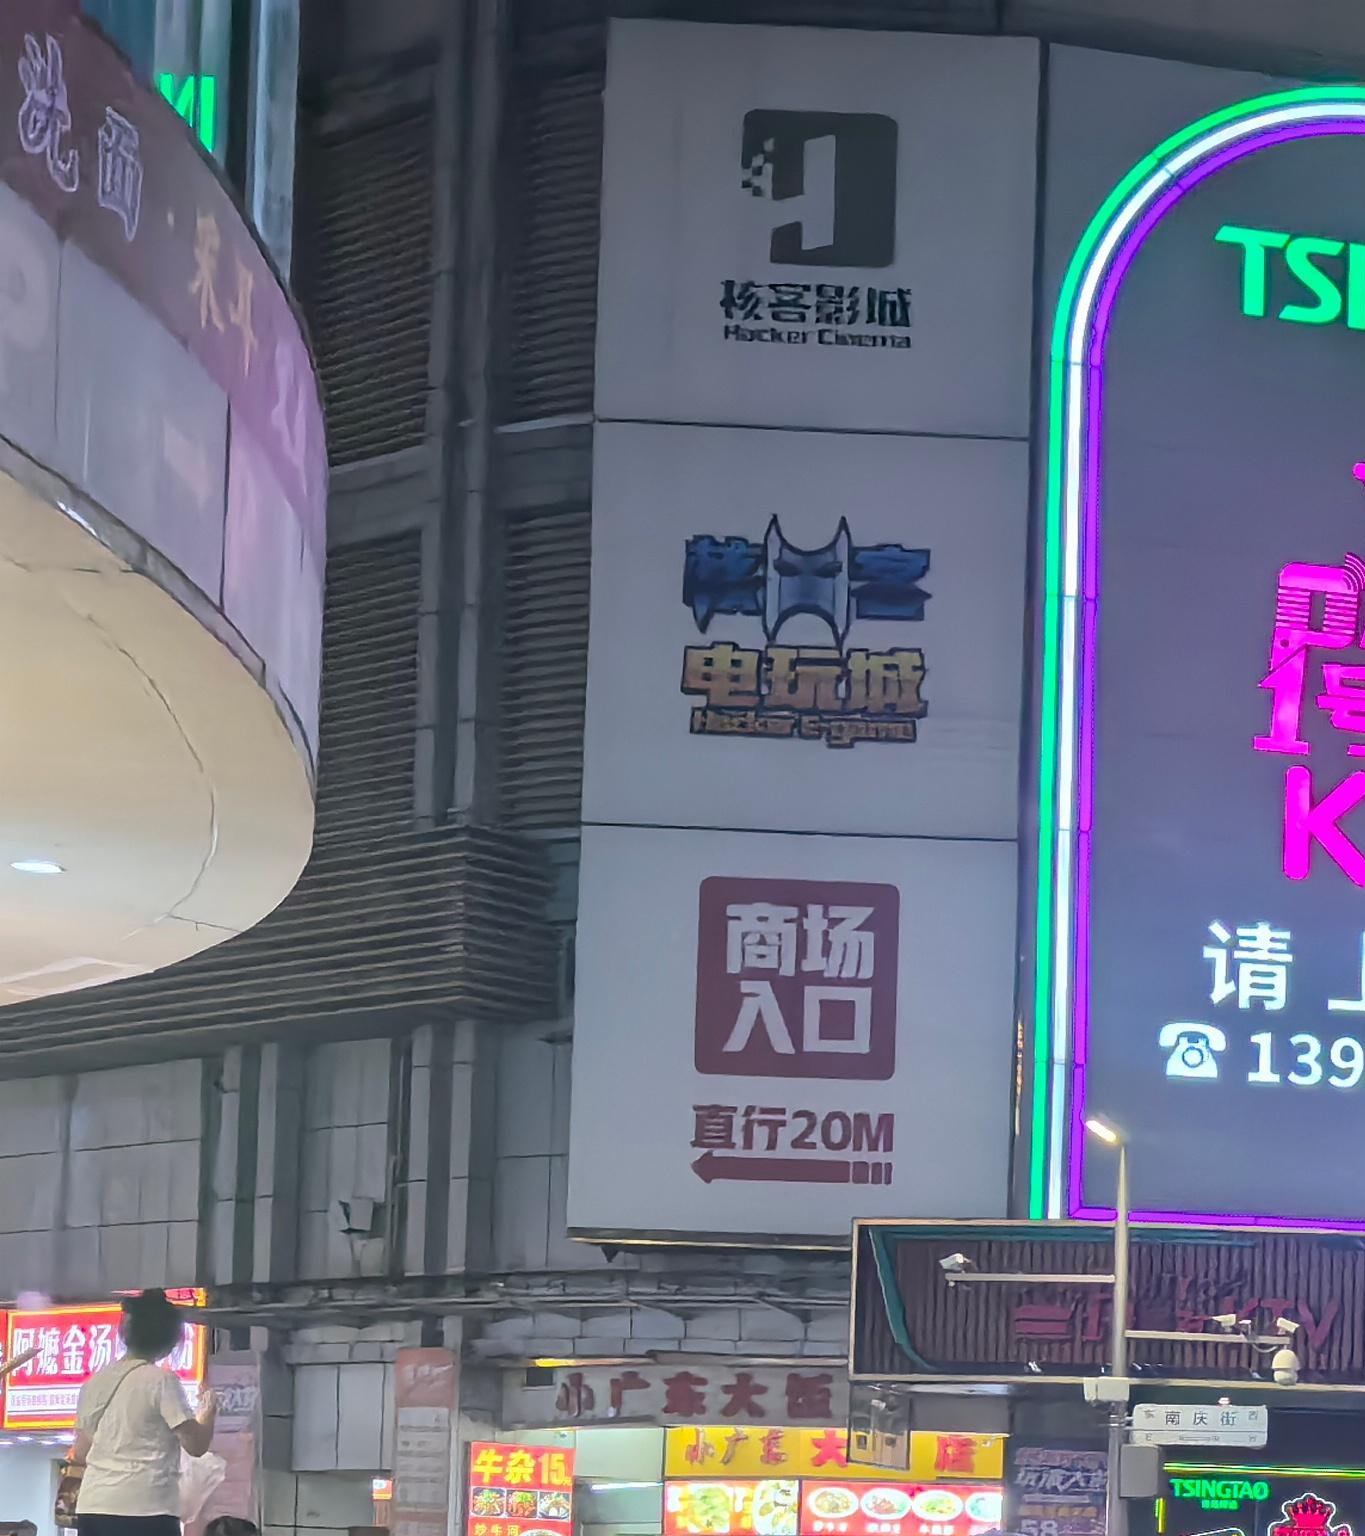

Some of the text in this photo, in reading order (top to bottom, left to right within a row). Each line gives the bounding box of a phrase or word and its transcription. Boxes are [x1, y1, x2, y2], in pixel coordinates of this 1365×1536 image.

[719, 279, 912, 327] 核客影城
[723, 324, 912, 348] Hacker Cinema
[680, 640, 928, 718] 电玩城
[725, 901, 875, 979] 商场
[721, 980, 873, 1055] 入口
[690, 1103, 895, 1153] 直行20M
[1164, 1410, 1239, 1426] 南庆街
[1169, 1479, 1270, 1501] TSINGTAO
